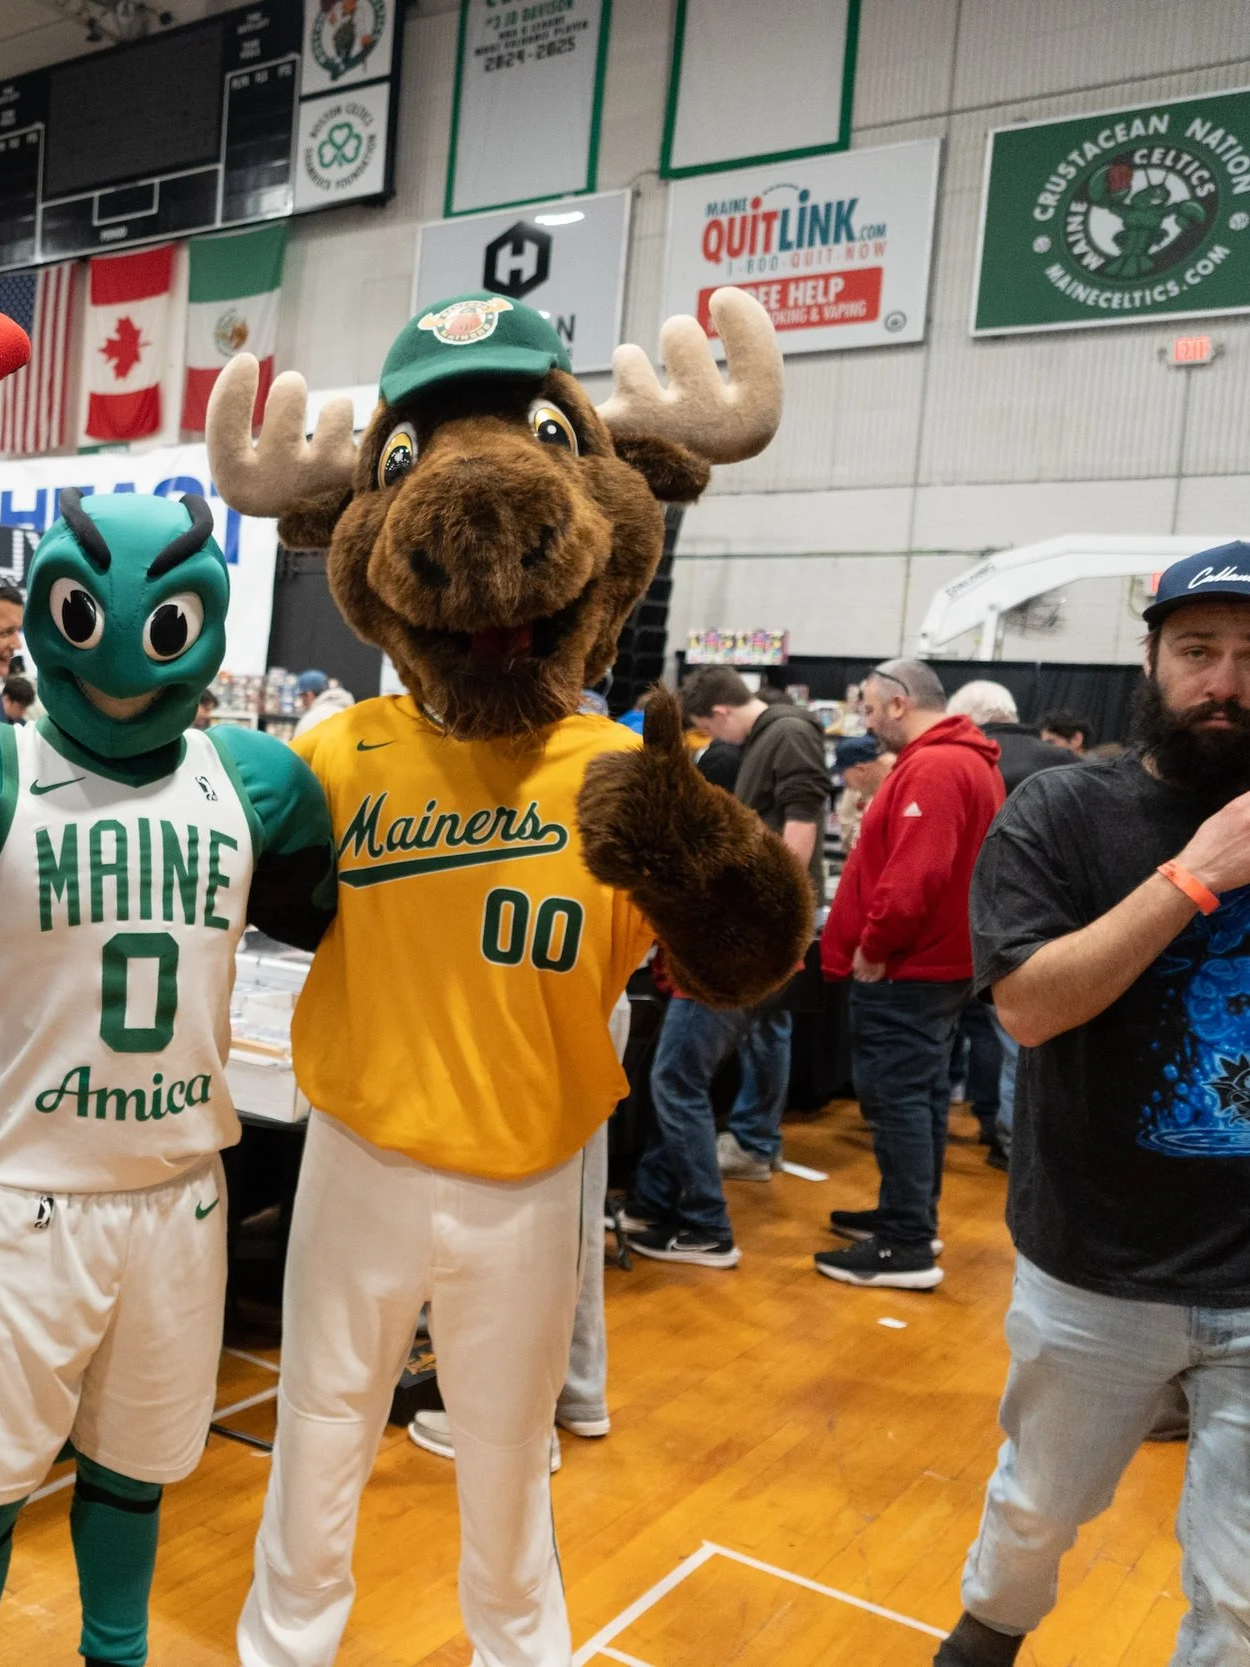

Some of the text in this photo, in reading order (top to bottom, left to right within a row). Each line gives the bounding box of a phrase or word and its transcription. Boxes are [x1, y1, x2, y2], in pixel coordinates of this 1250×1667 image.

[1033, 114, 1250, 221] CRUSTACEAN NATION
[706, 197, 749, 218] MAINE
[1067, 147, 1216, 271] MAINE CELTICS
[787, 276, 845, 307] HELP
[1045, 244, 1231, 309] MAINECELTICS.COM
[338, 791, 568, 860] Mainers
[35, 817, 238, 932] MAINE
[481, 886, 584, 974] 00
[100, 932, 179, 1053] 0
[35, 1066, 212, 1122] Amica
